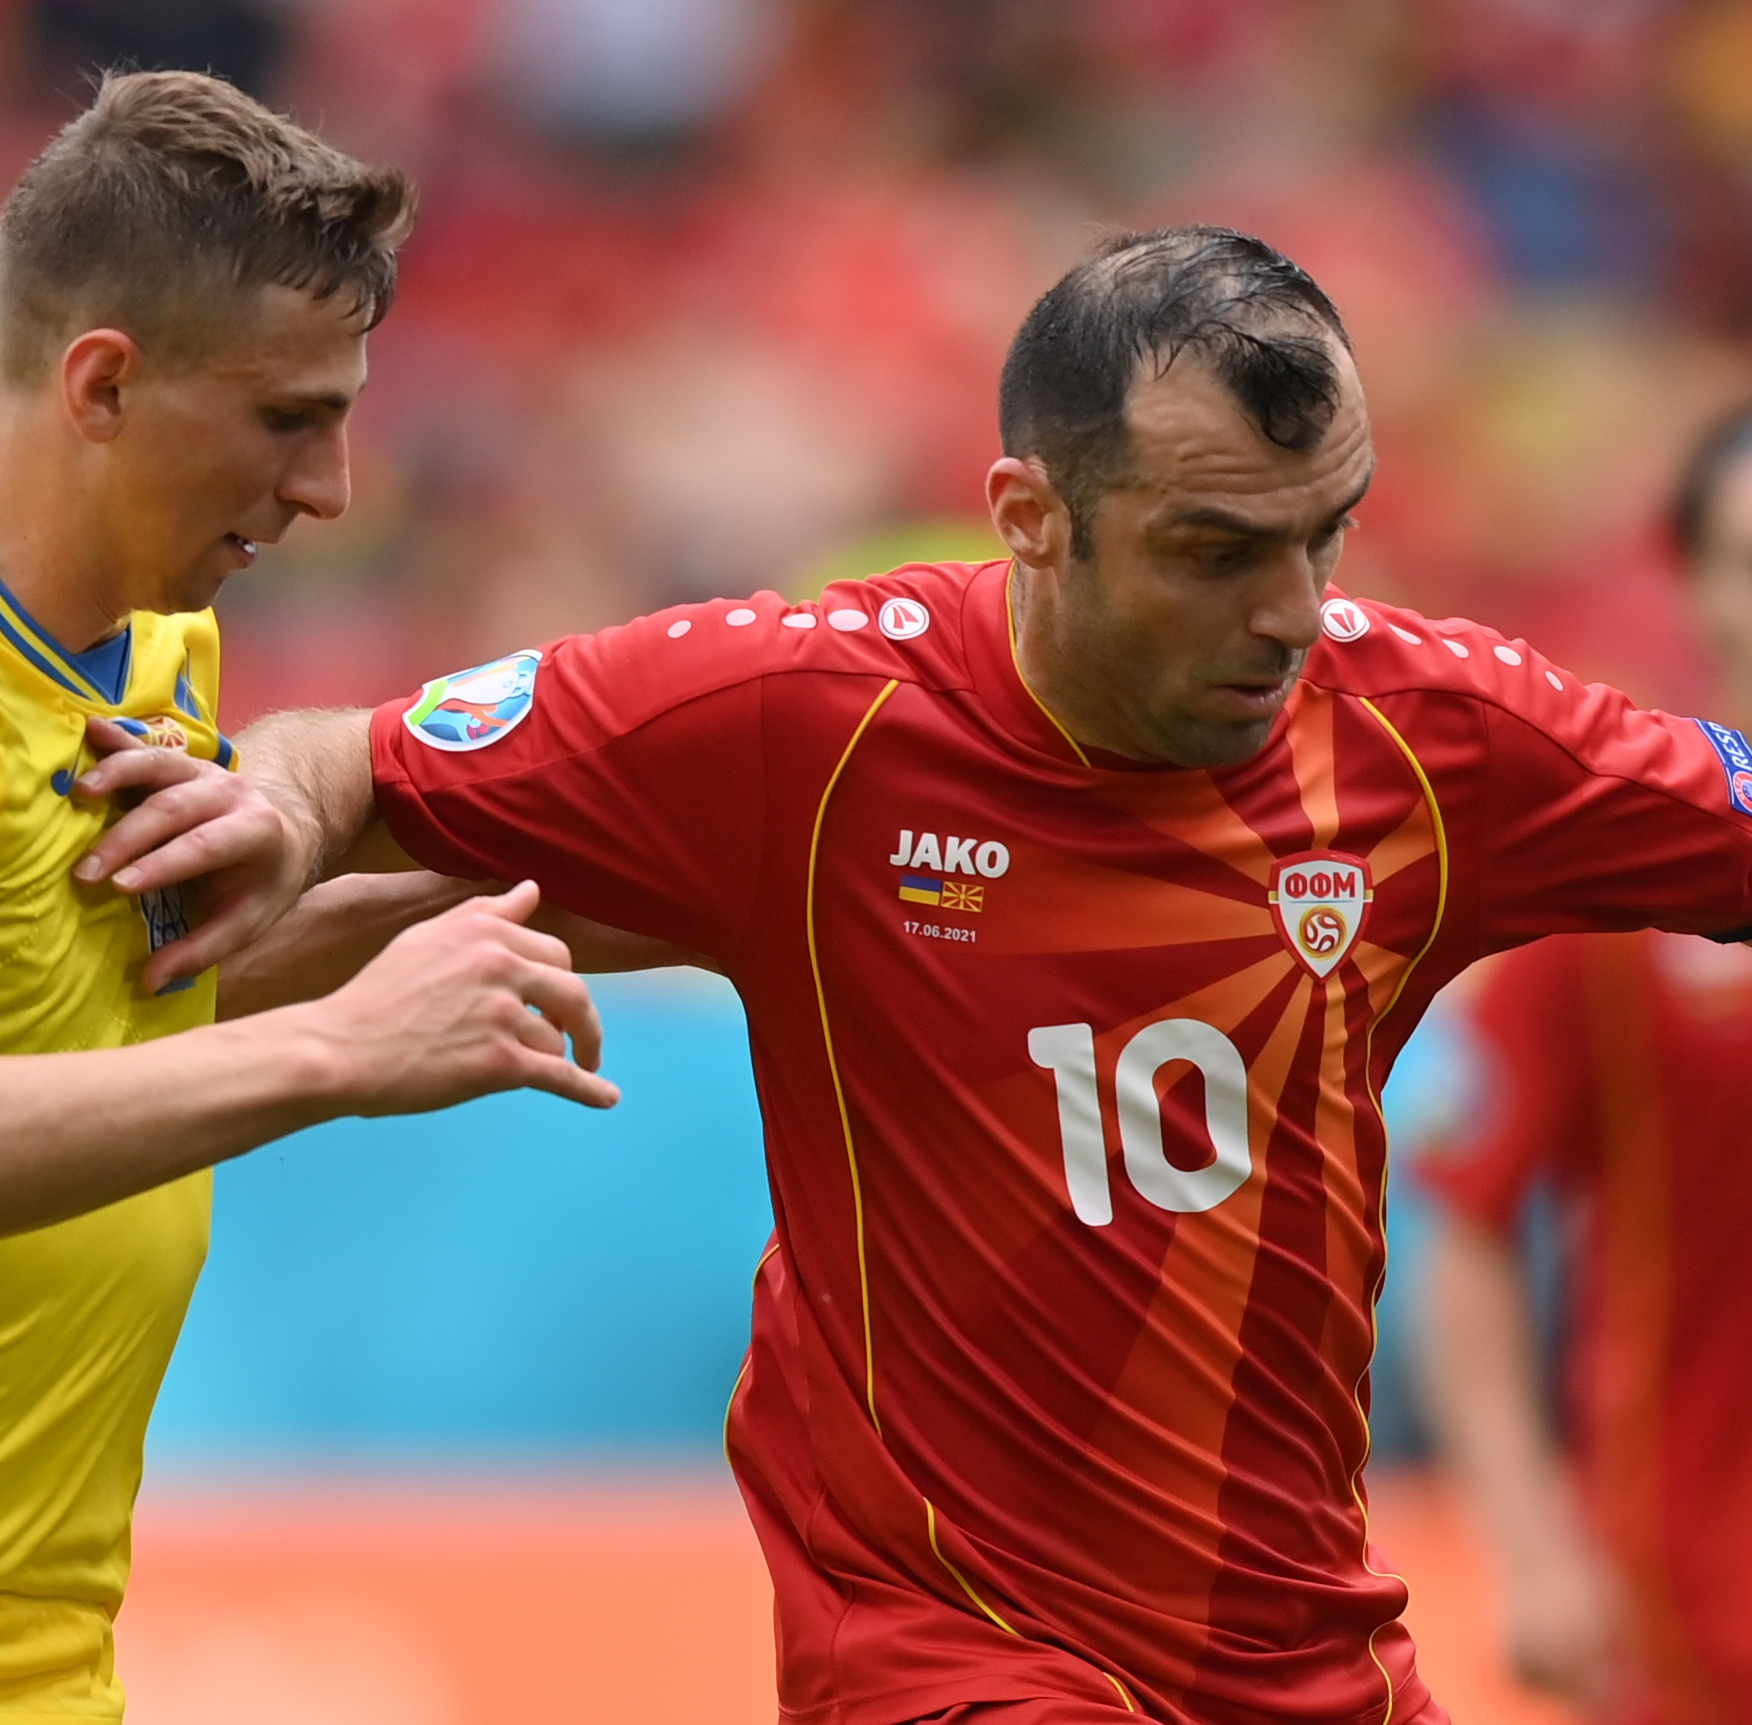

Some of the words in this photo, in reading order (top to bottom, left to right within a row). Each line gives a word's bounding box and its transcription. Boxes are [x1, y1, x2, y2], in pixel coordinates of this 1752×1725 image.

[889, 829, 1011, 879] JAKO
[1284, 871, 1356, 899] ФФМ
[903, 920, 977, 943] 17.06.2021
[1027, 1017, 1252, 1227] 10
